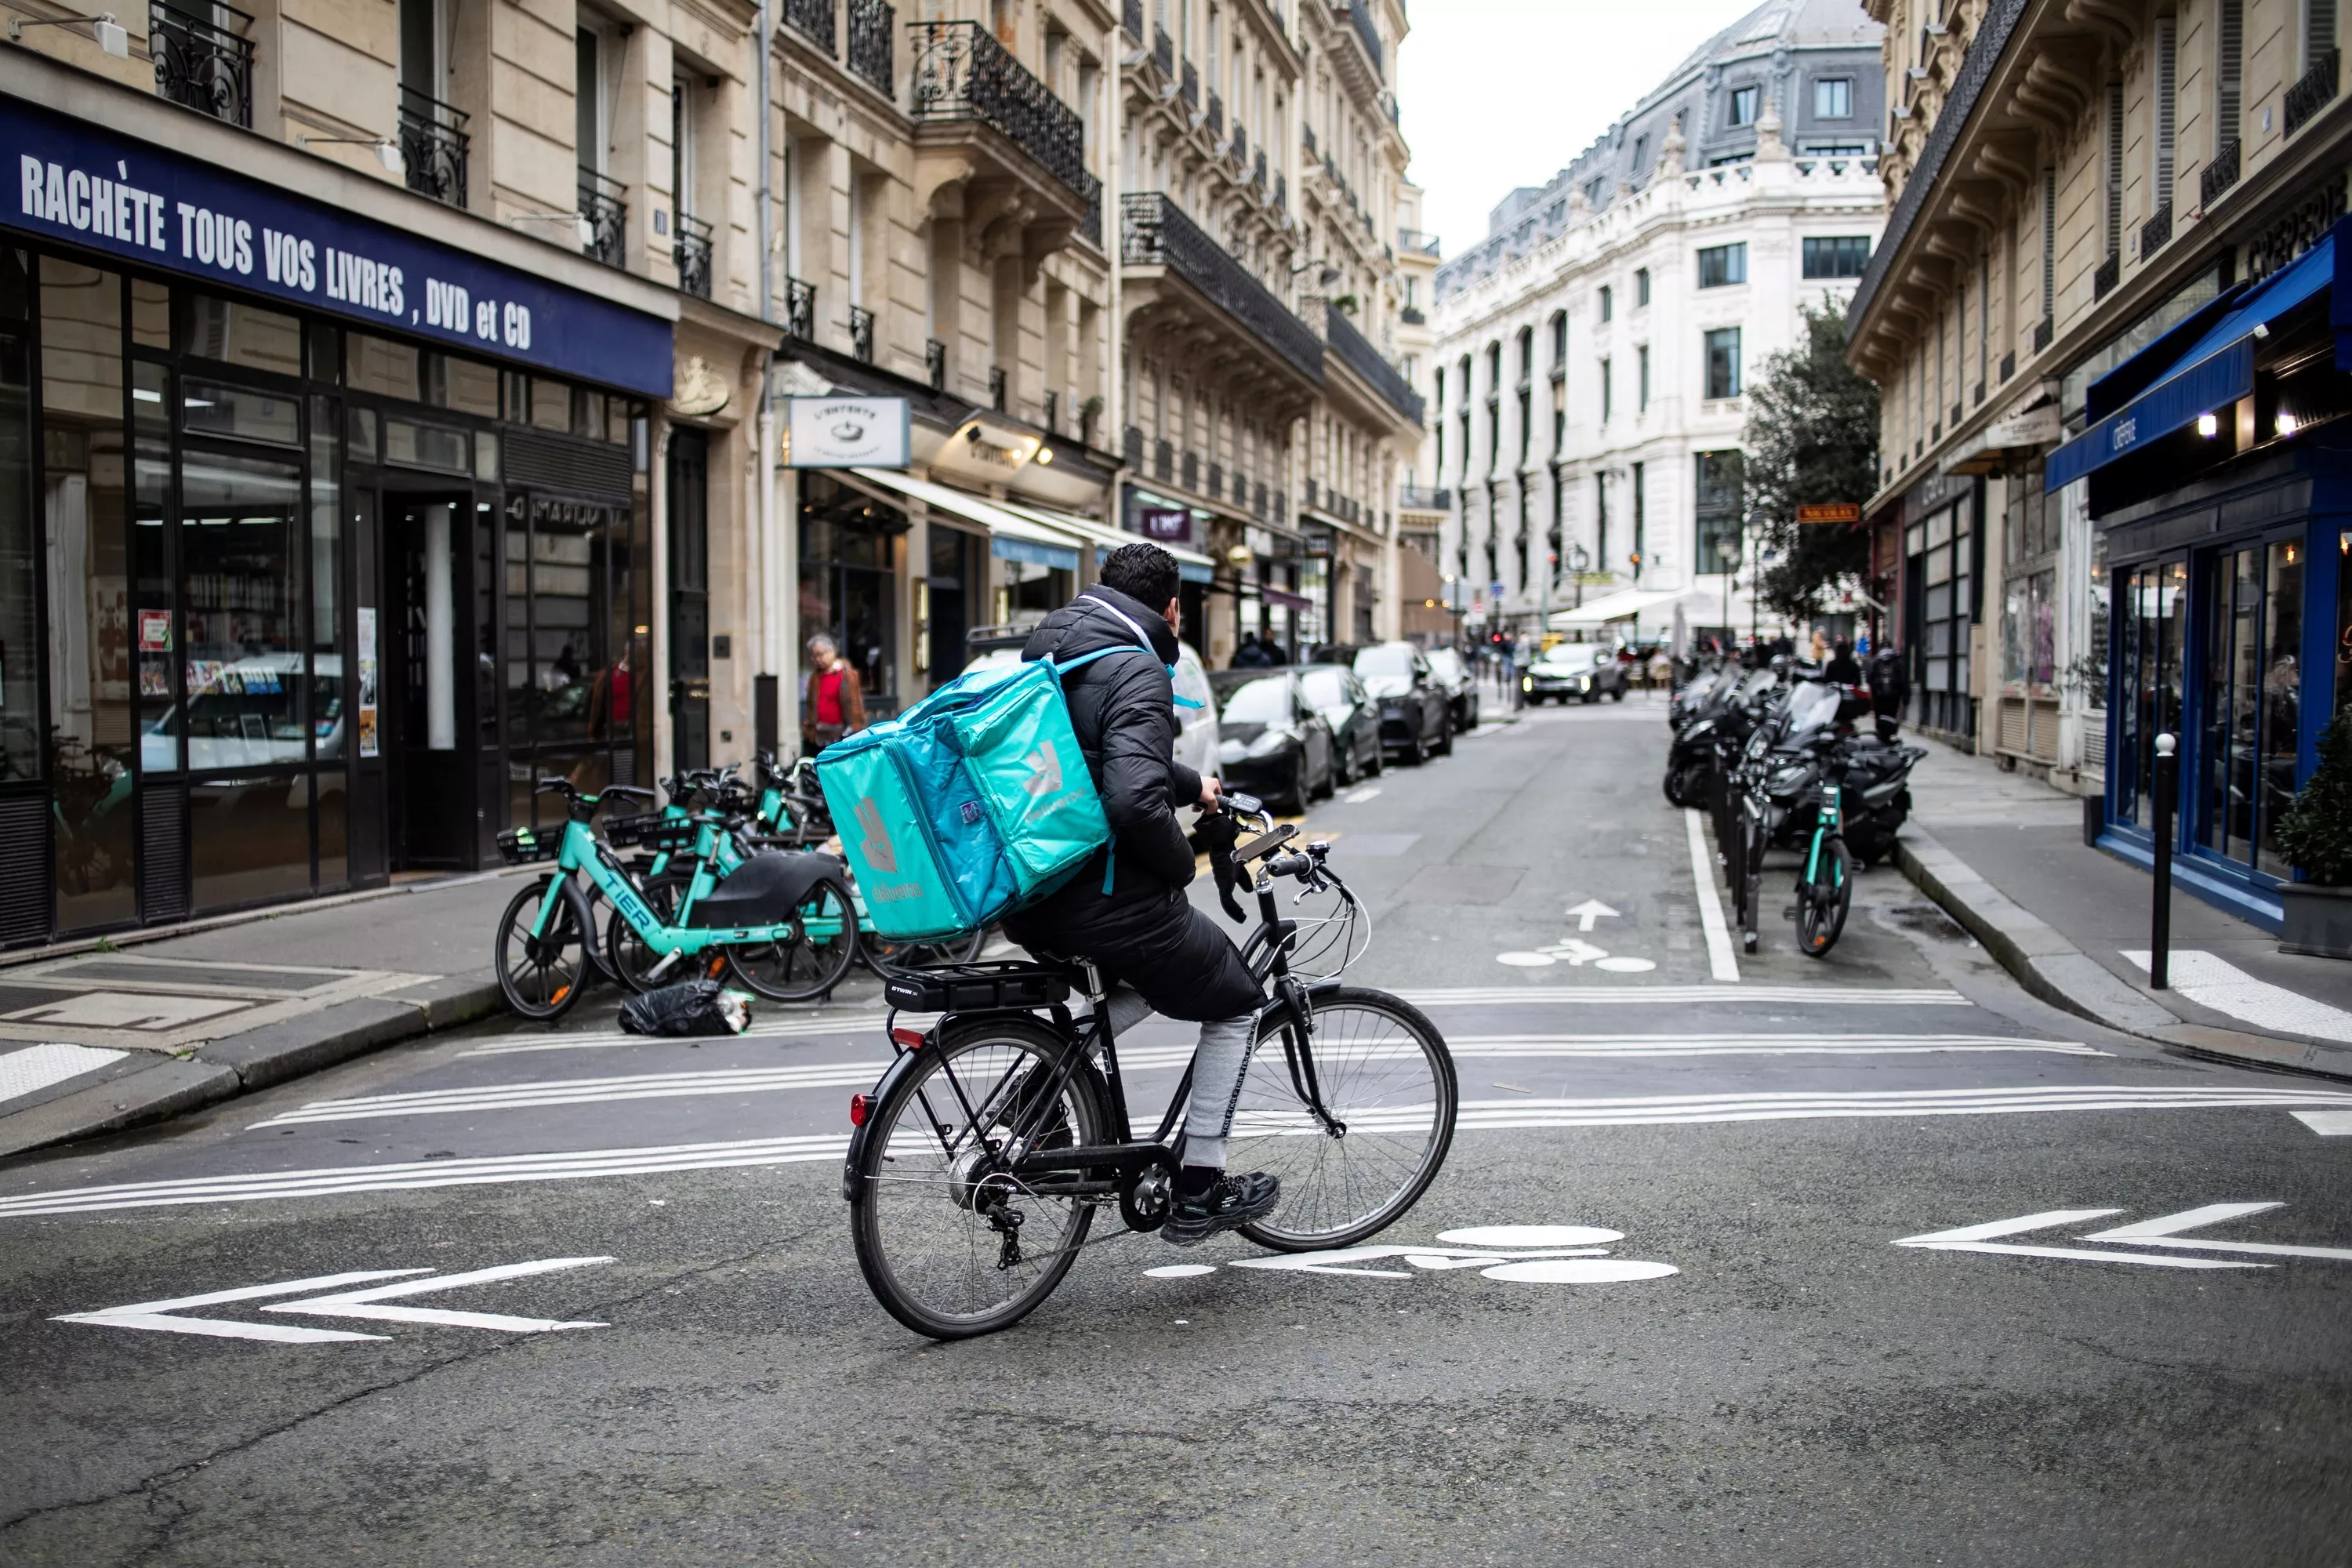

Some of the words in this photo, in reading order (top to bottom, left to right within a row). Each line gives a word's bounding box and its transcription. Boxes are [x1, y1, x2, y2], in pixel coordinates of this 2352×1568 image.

[21, 154, 165, 251] RACHÈTE
[178, 202, 252, 275] TOUS
[263, 228, 315, 292] VOS
[326, 247, 404, 316] LIVRES
[426, 278, 469, 332] DVD
[476, 299, 497, 342] et
[504, 301, 531, 350] CD
[605, 873, 650, 931] TIER
[873, 881, 924, 903] deliveroo
